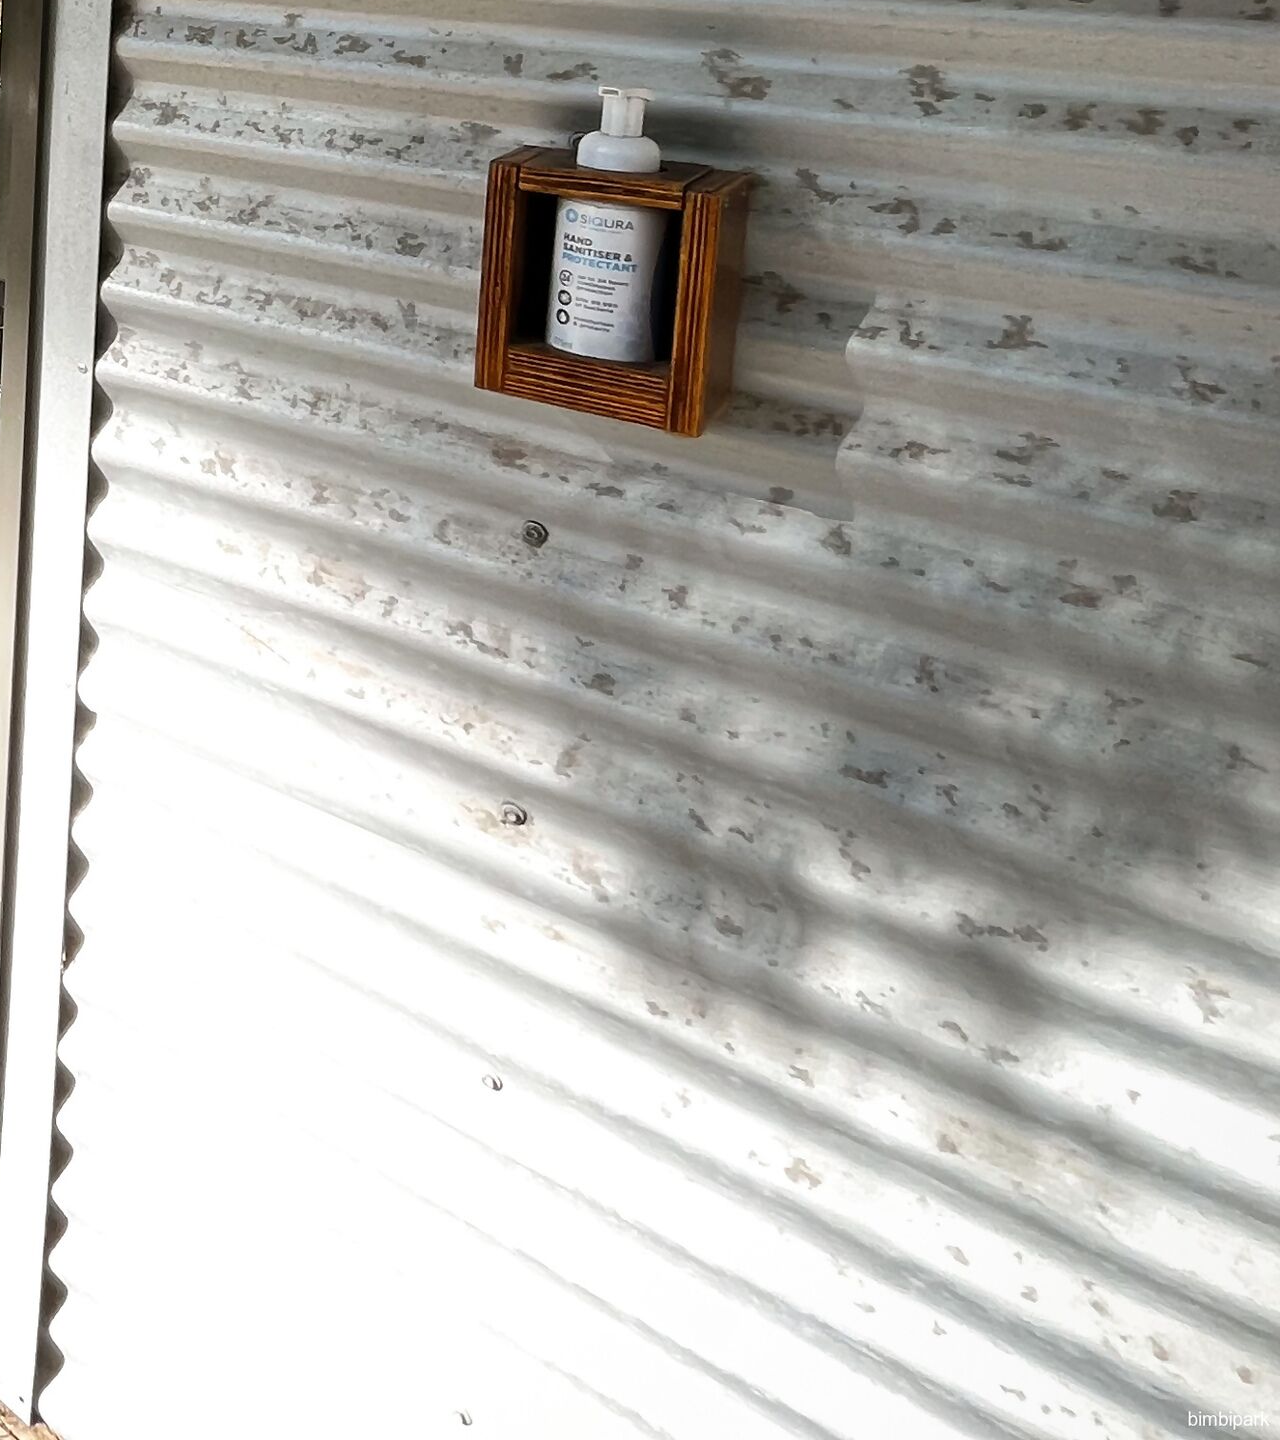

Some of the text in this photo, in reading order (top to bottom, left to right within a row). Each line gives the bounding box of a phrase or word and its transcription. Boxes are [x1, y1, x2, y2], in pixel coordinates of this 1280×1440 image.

[580, 214, 634, 231] SIQURA
[563, 232, 593, 247] HAND
[563, 243, 633, 262] SANITISER &
[561, 252, 638, 273] PROTECTANT
